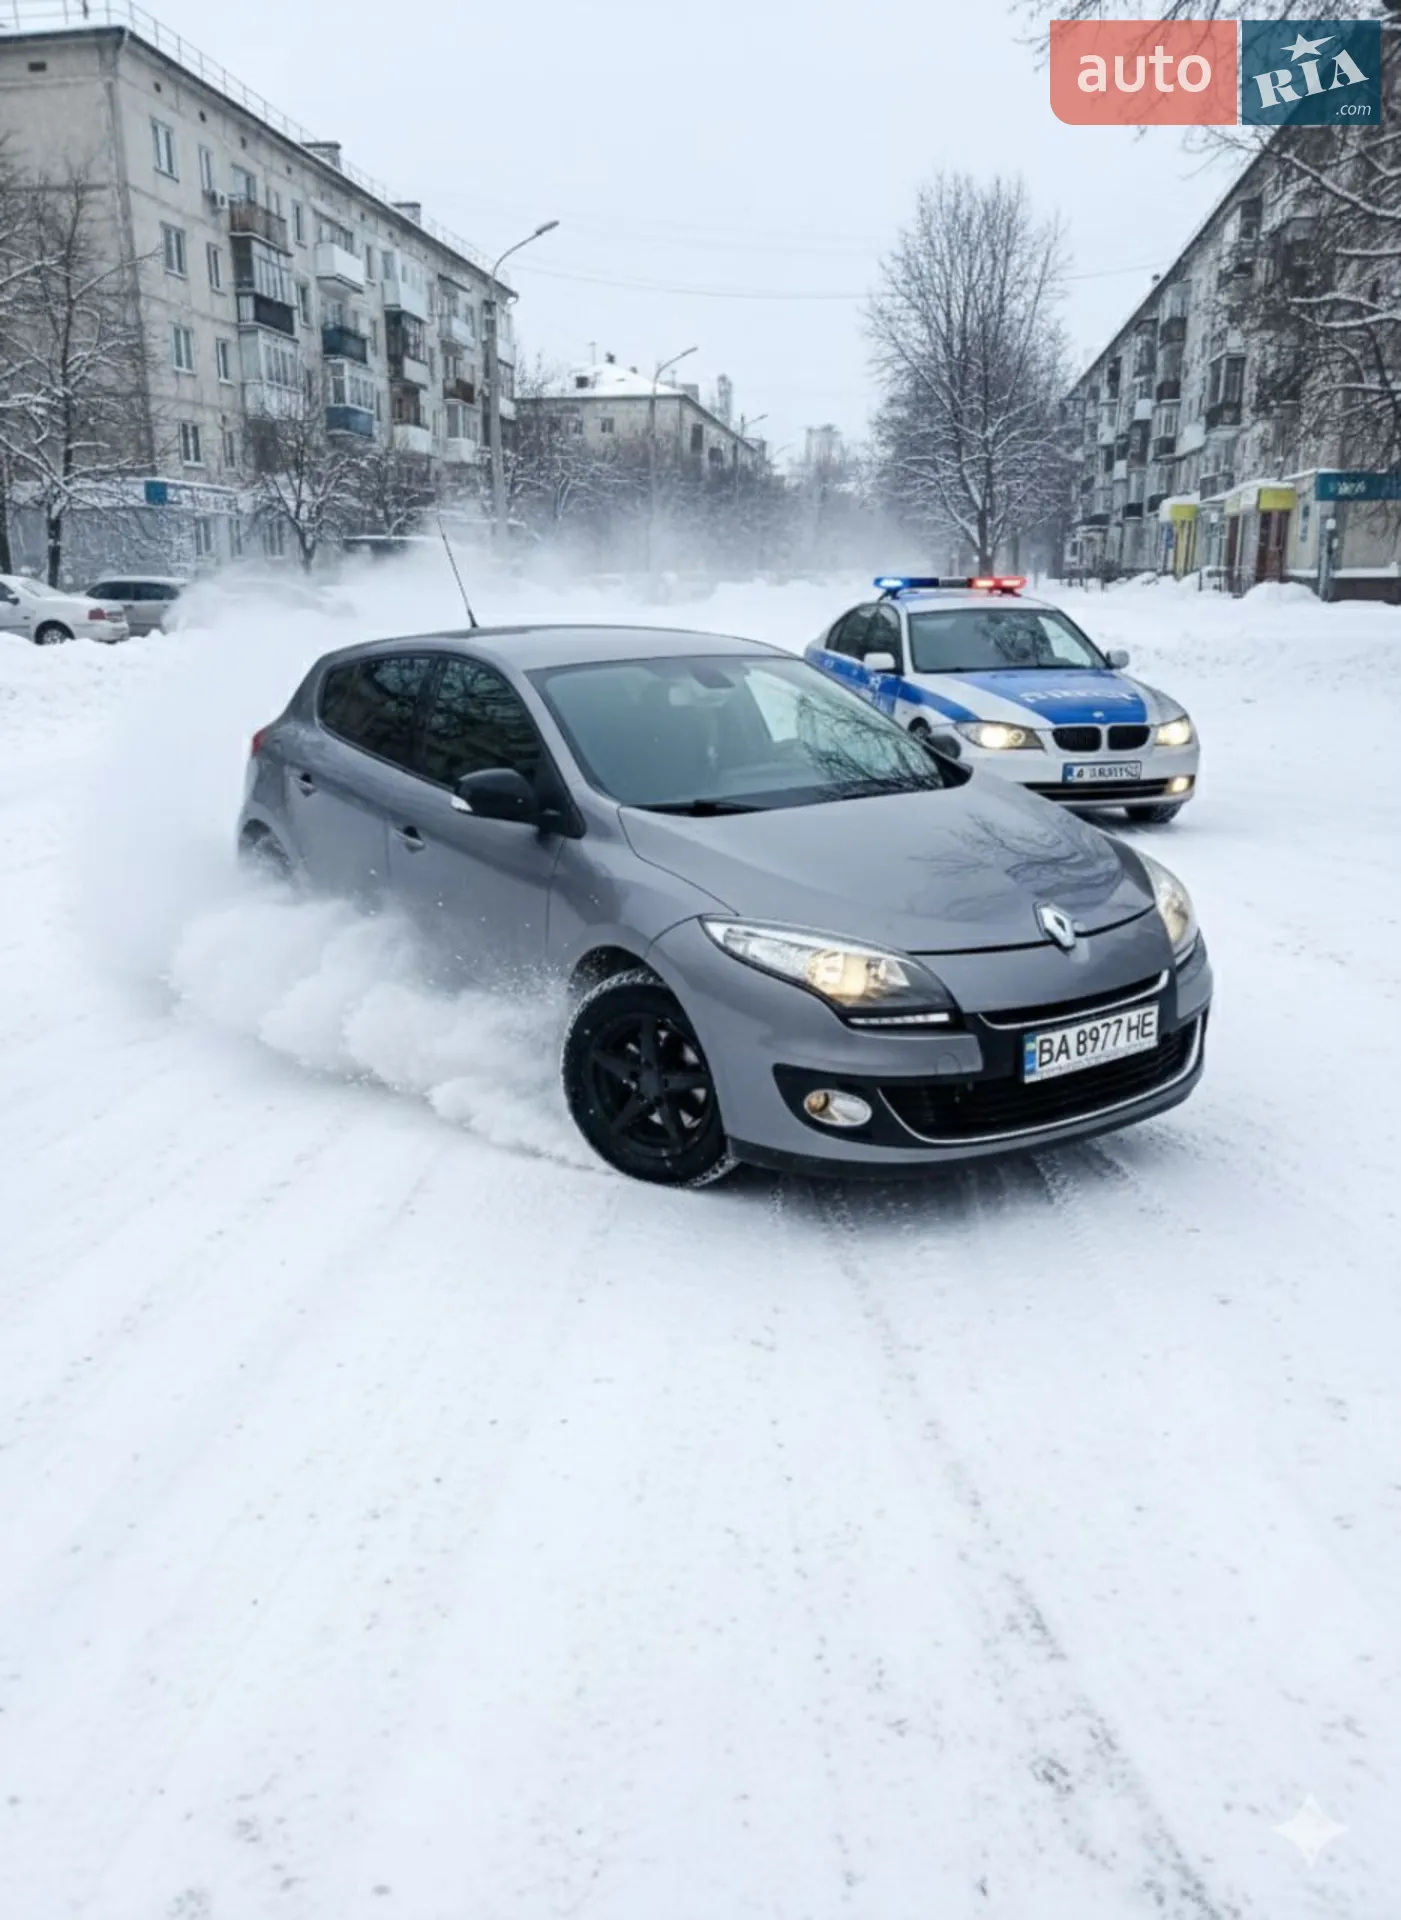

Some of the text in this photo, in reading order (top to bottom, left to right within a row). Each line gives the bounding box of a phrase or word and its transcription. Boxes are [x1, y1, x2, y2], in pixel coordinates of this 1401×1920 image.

[1038, 1011, 1155, 1067] BA 8977 HE
